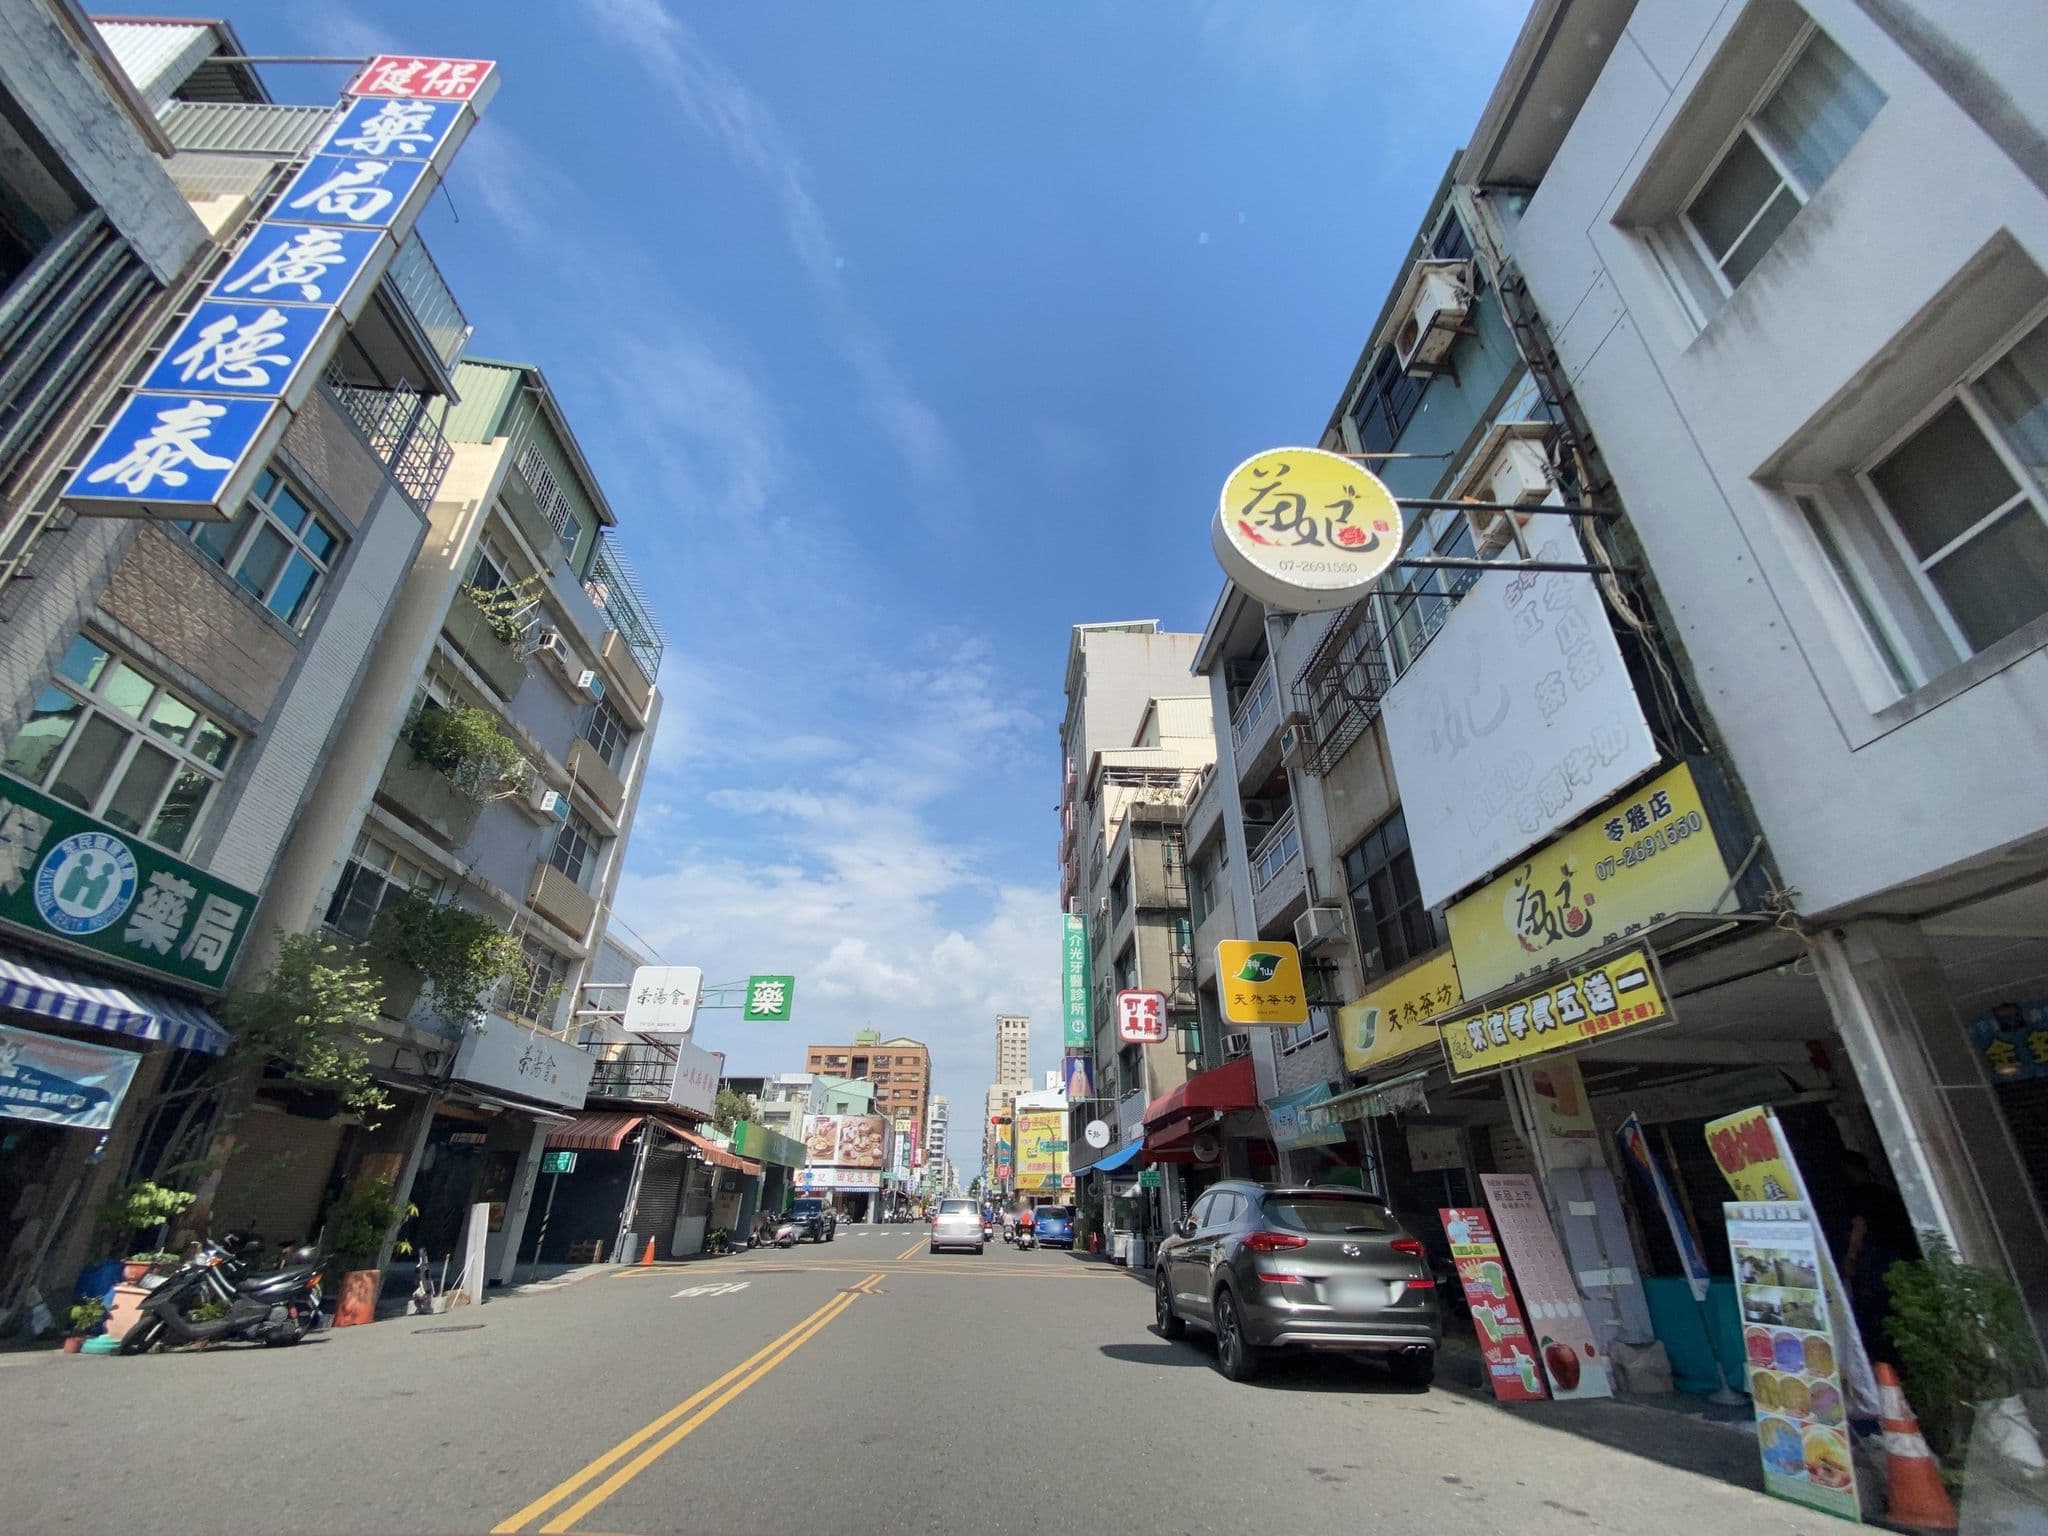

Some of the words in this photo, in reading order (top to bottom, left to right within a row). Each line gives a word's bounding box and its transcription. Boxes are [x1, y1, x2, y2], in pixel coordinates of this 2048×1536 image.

[366, 60, 482, 97] 健保
[1278, 560, 1358, 573] 07-2691550
[1603, 790, 1672, 842] 苓雅店
[1595, 810, 1703, 881] 07-2691550
[124, 869, 244, 972] 藥局
[1068, 934, 1086, 1016] 介光牙醫診所
[637, 986, 685, 1006] 茶湯會
[751, 981, 785, 1015] 藥
[1234, 993, 1297, 1006] 天然茶坊
[1388, 983, 1452, 1033] 天然茶坊
[518, 1044, 557, 1082] 茶湯會
